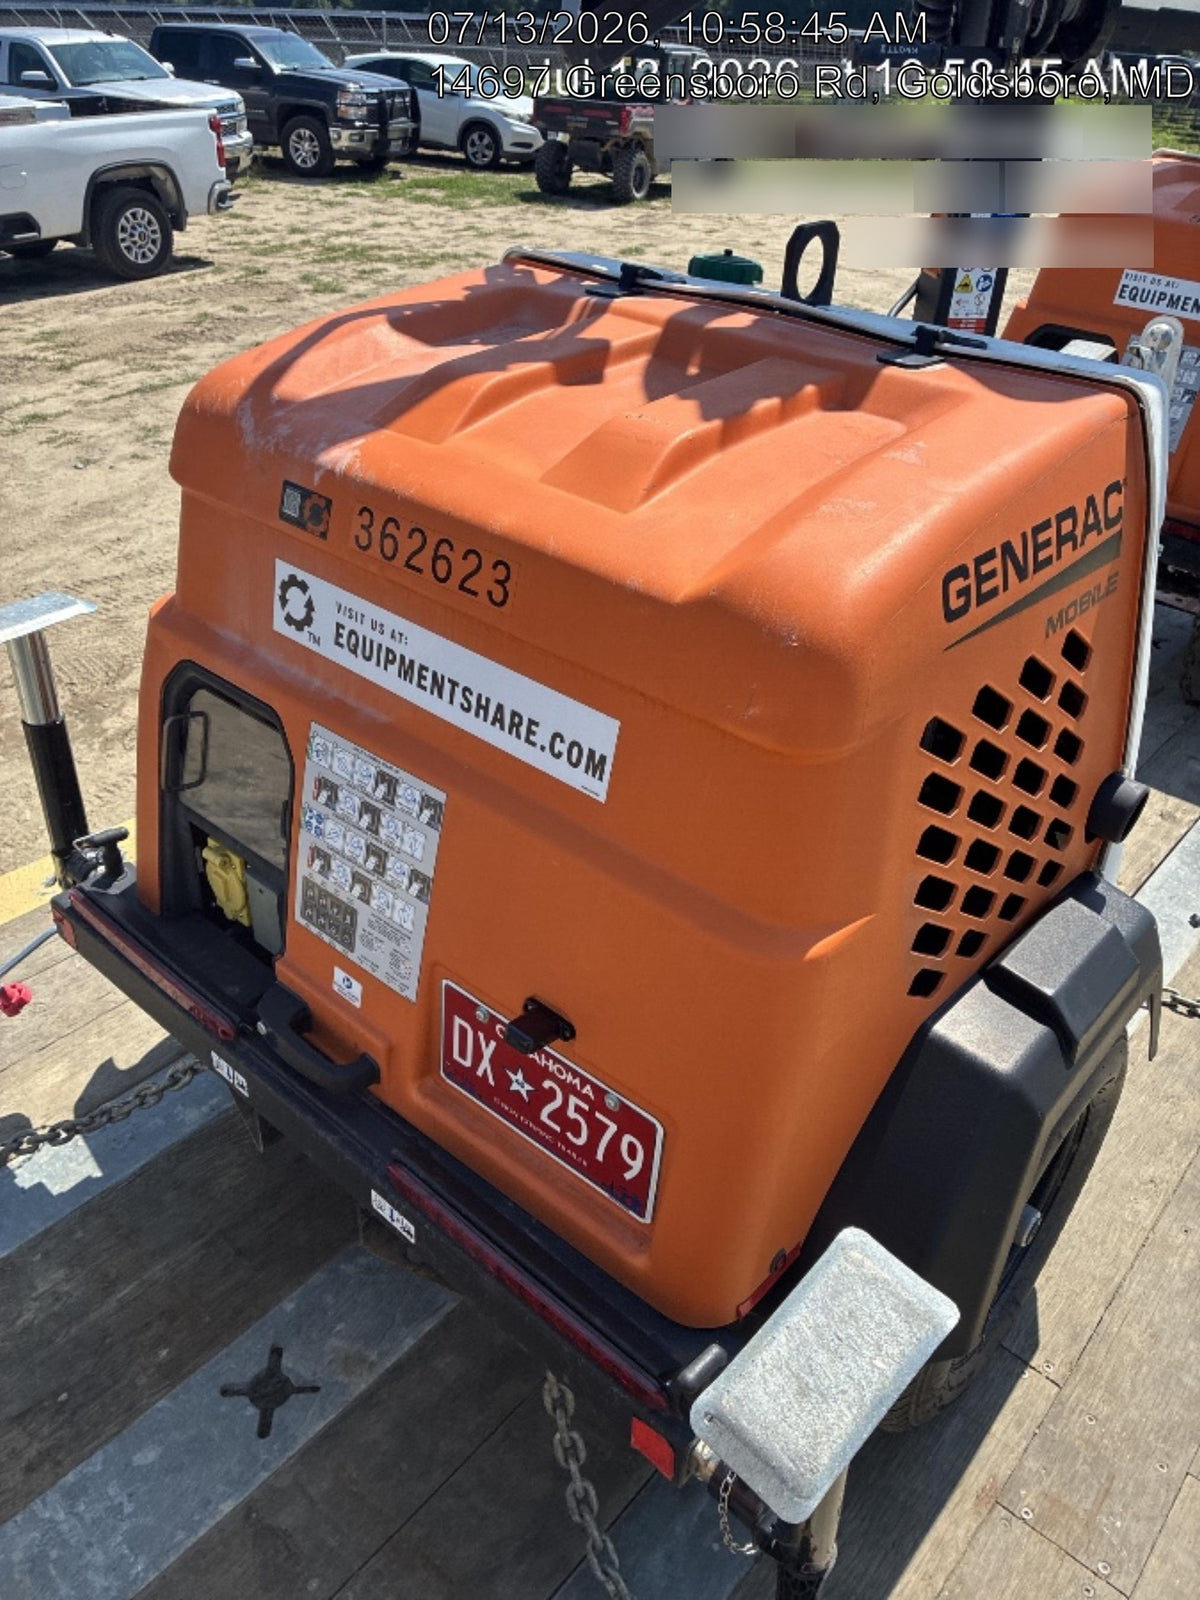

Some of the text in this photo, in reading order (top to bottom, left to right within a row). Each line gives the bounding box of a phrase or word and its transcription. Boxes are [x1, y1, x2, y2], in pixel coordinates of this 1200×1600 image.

[354, 506, 512, 608] 362623
[942, 480, 1123, 623] GENERAC
[1045, 572, 1119, 639] MOBILE
[336, 600, 408, 645] VISIT US AT:
[334, 622, 608, 782] EQUIPMENTSHARE.COM
[452, 1014, 645, 1181] DX 2579
